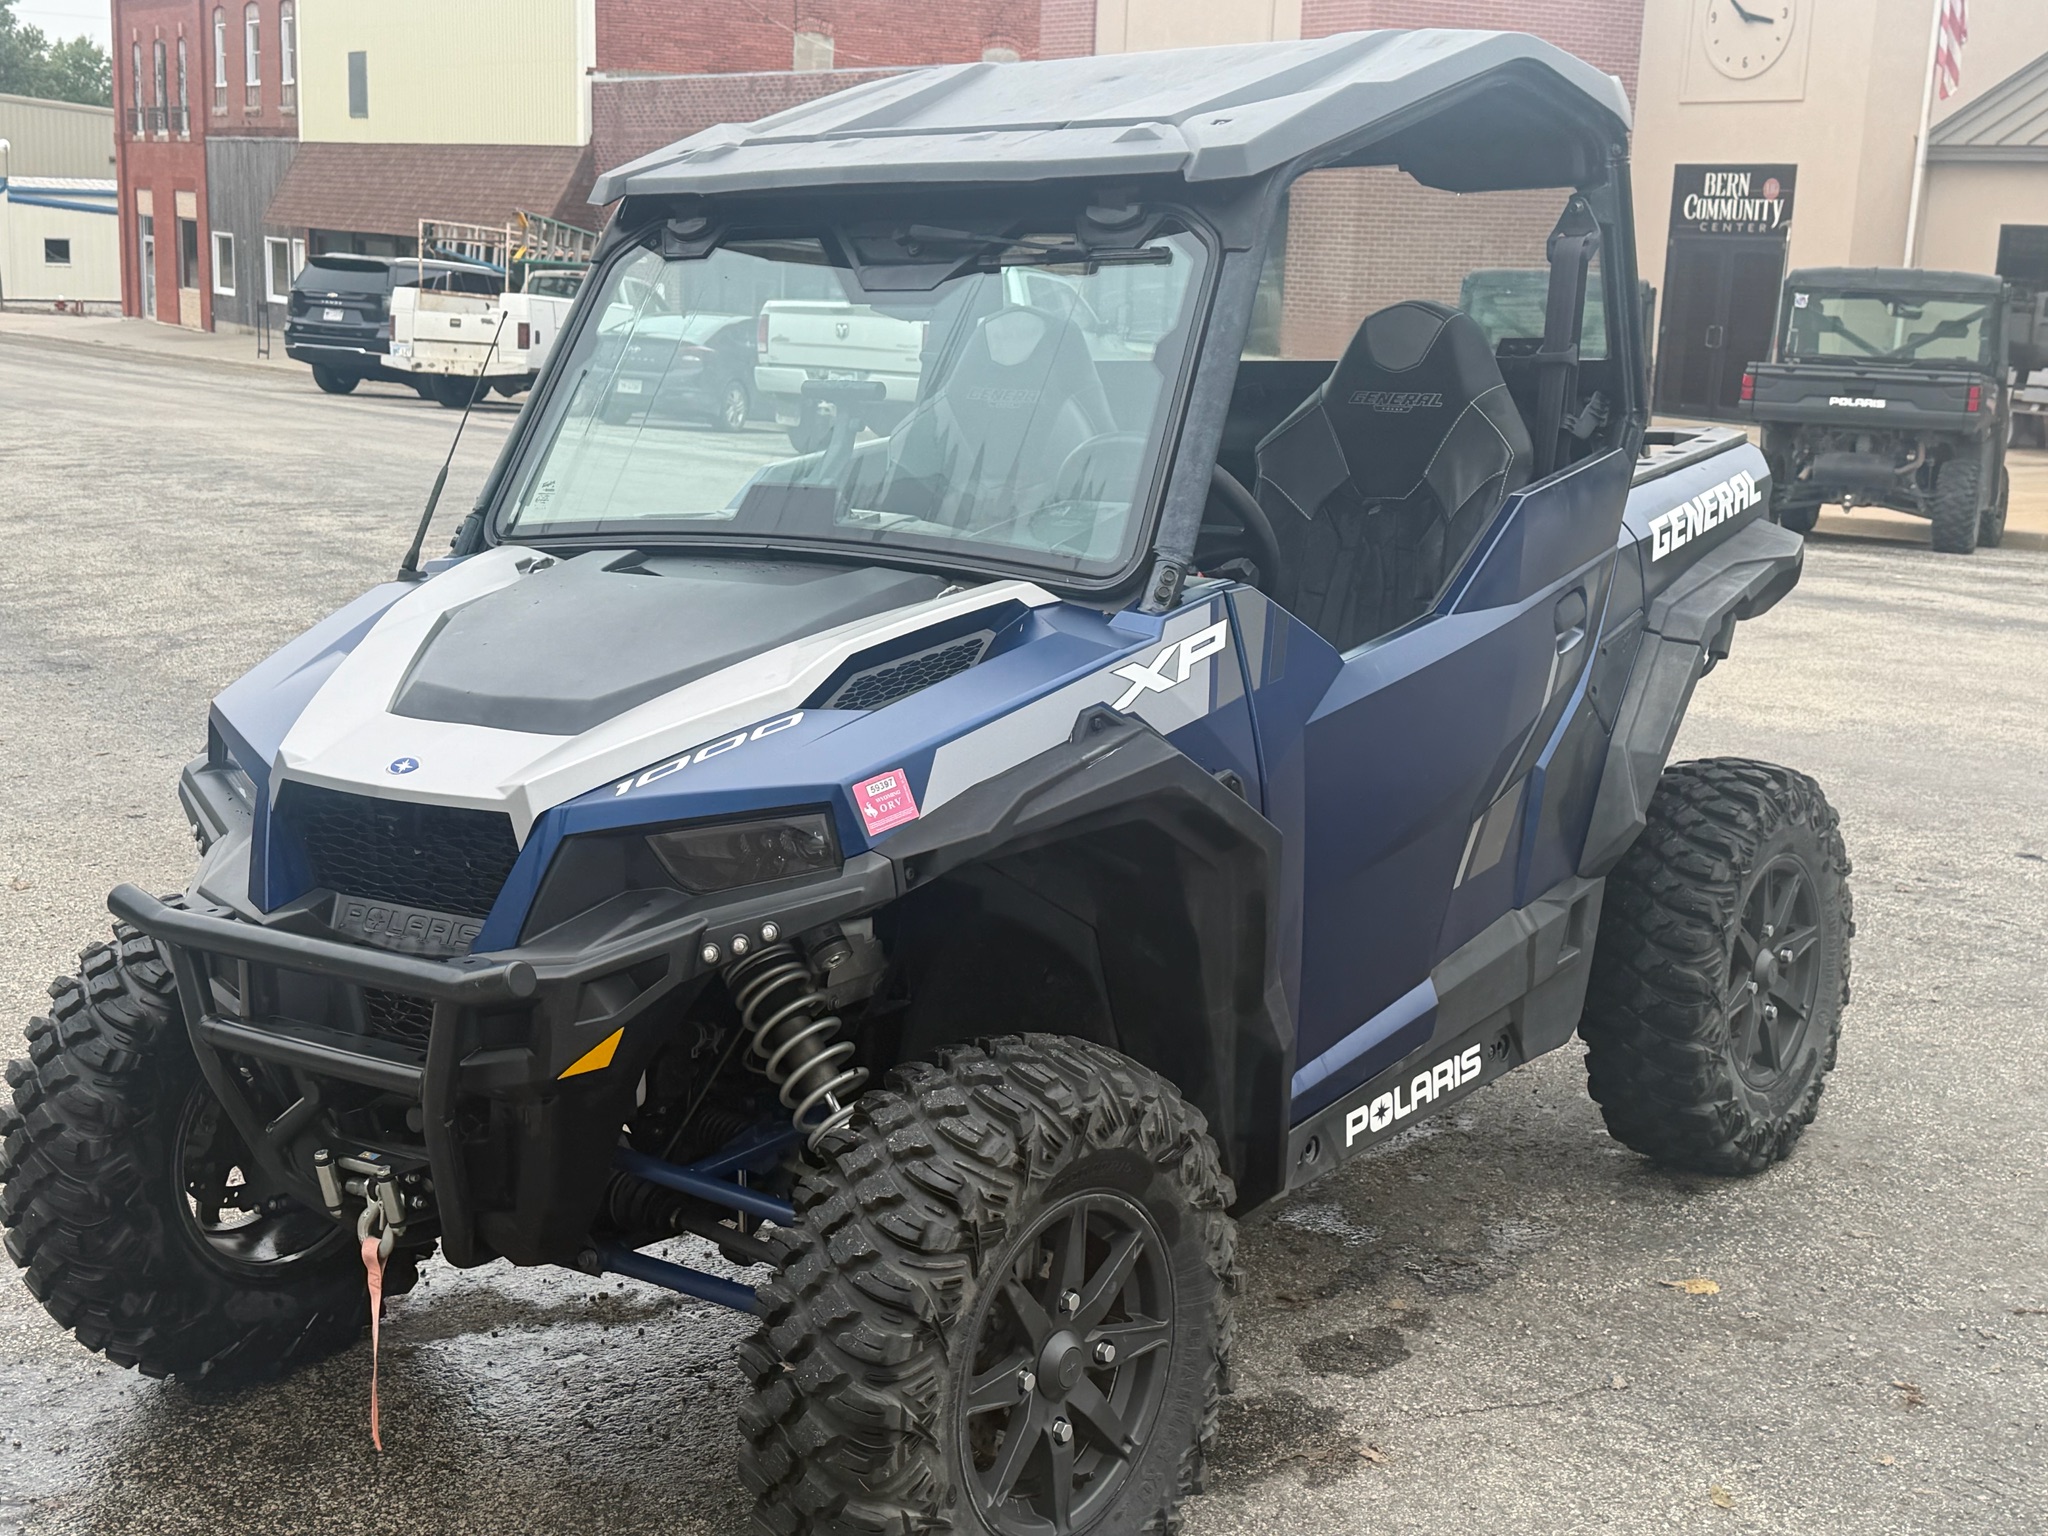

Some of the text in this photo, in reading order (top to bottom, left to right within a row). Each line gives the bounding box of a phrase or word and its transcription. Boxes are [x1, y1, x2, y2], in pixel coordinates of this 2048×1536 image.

[1711, 11, 1717, 24] 9
[1742, 56, 1748, 69] 6
[1704, 172, 1751, 200] BERN
[1700, 222, 1767, 233] CENTER
[1348, 391, 1443, 407] GENERAL
[1829, 396, 1886, 408] POLARIS
[1648, 470, 1762, 563] GENERAL
[1109, 619, 1227, 711] XP
[615, 711, 804, 797] 1000
[870, 778, 893, 794] 59397
[875, 790, 901, 803] WYOMING
[879, 797, 902, 813] ORV
[339, 902, 482, 948] POLARIS
[1346, 1043, 1482, 1148] POLARIS
